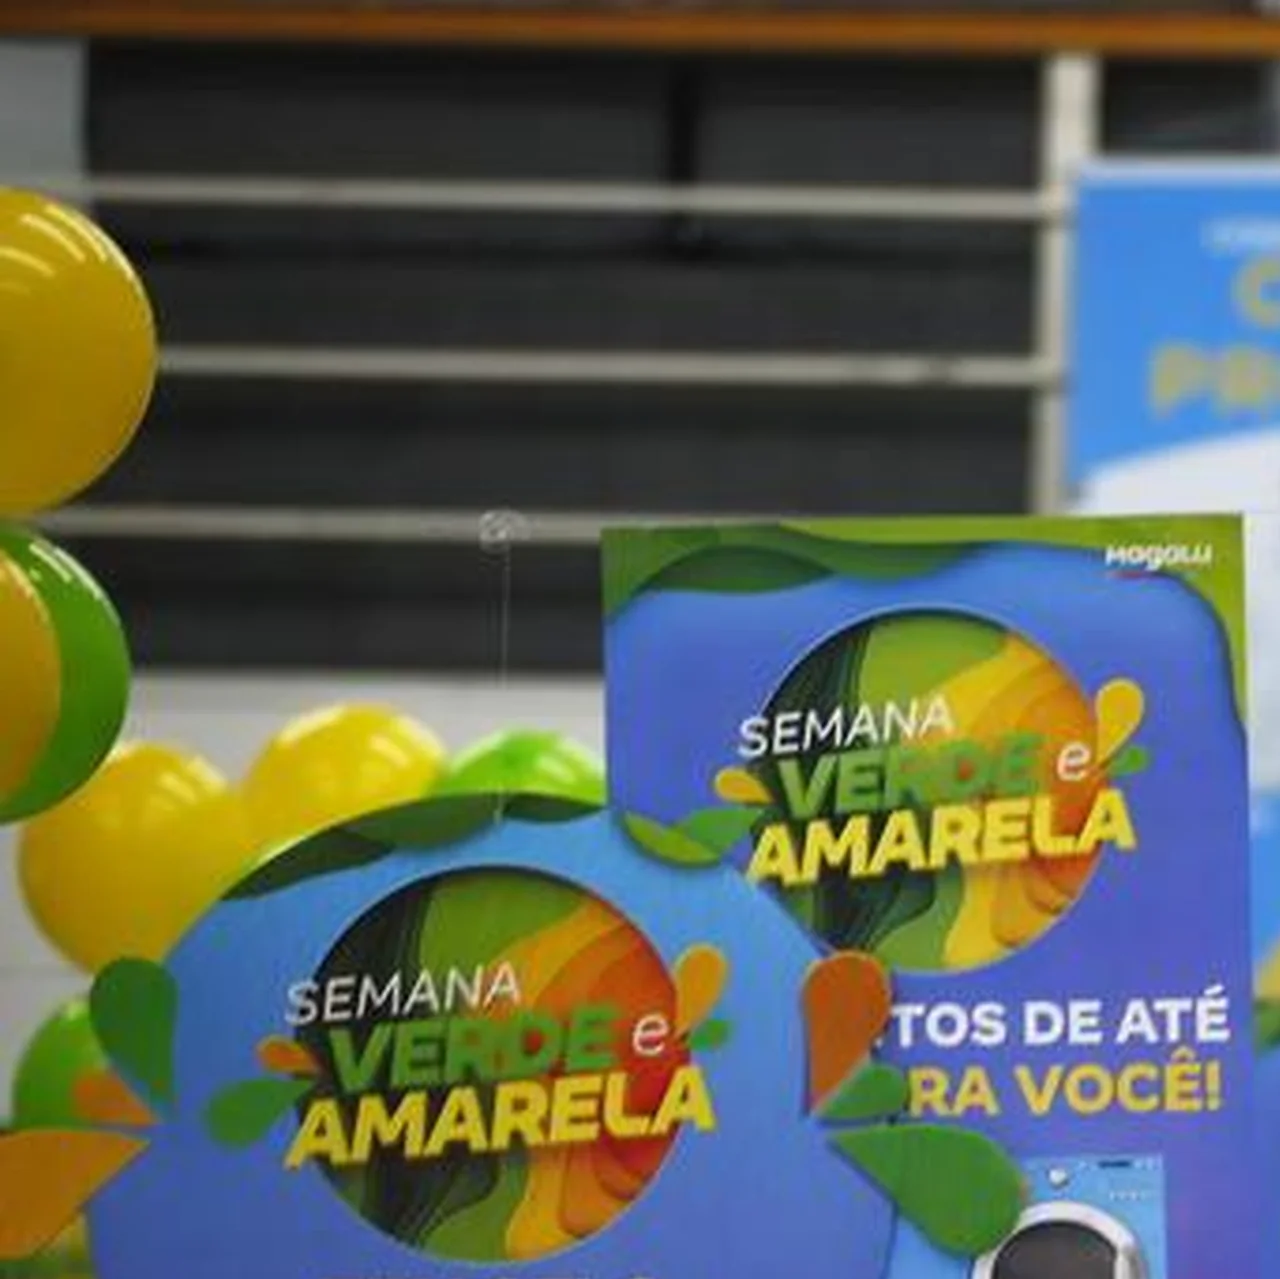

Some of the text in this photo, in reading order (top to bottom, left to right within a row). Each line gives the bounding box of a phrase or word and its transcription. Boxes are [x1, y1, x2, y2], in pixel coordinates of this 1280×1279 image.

[738, 696, 955, 757] SEMANA
[778, 734, 1090, 819] VERDE e
[747, 790, 1136, 888] AMARELA
[285, 961, 521, 1026] SEMANA
[1024, 997, 1101, 1046] DE
[1117, 985, 1230, 1043] ATÉ
[327, 1005, 669, 1092] VERDE e
[1015, 1047, 1222, 1115] VOCÊ!
[284, 1068, 716, 1168] AMARELA
